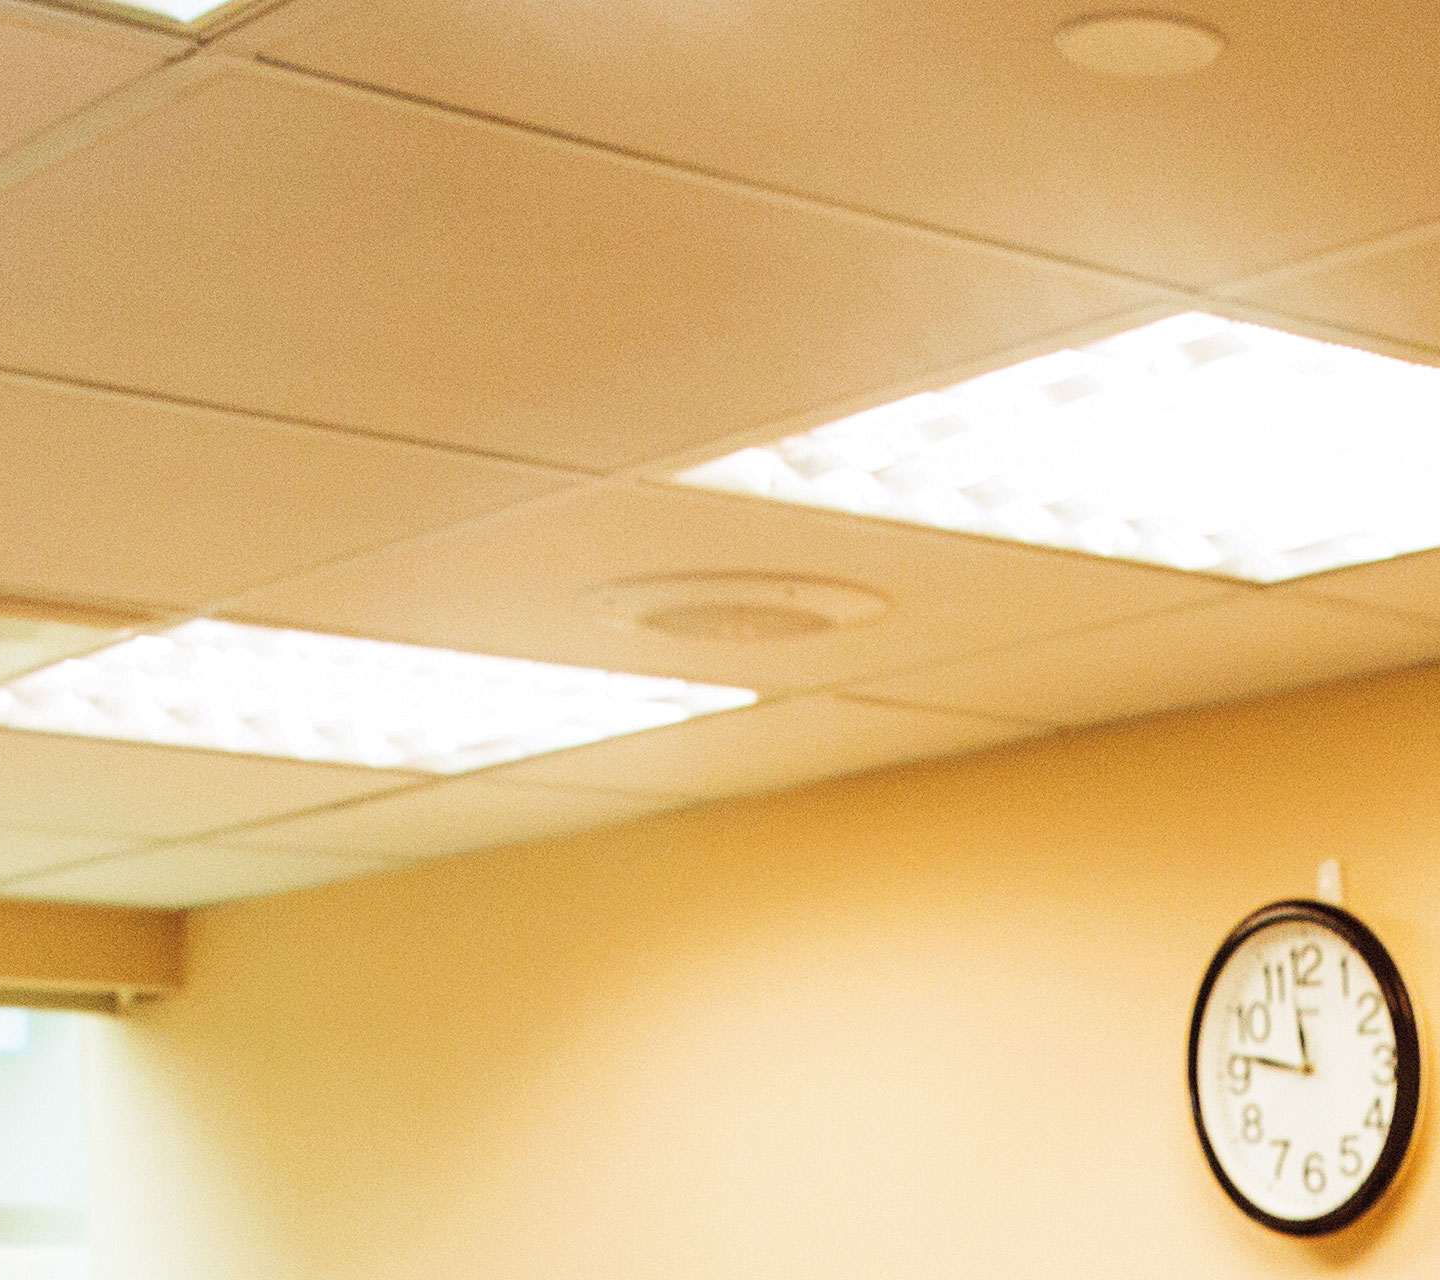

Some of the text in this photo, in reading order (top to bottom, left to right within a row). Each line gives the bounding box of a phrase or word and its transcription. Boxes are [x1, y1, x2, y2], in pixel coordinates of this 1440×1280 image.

[1263, 964, 1286, 1001] 11
[1291, 943, 1323, 987] 12
[1340, 956, 1350, 999] 1
[1236, 1001, 1271, 1043] 10
[1357, 991, 1382, 1036] 2
[1228, 1053, 1251, 1095] 9
[1372, 1043, 1398, 1087] 3
[1241, 1103, 1263, 1144] 8
[1364, 1097, 1385, 1136] 4
[1271, 1138, 1291, 1179] 7
[1303, 1152, 1327, 1193] 6
[1340, 1134, 1362, 1177] 5
